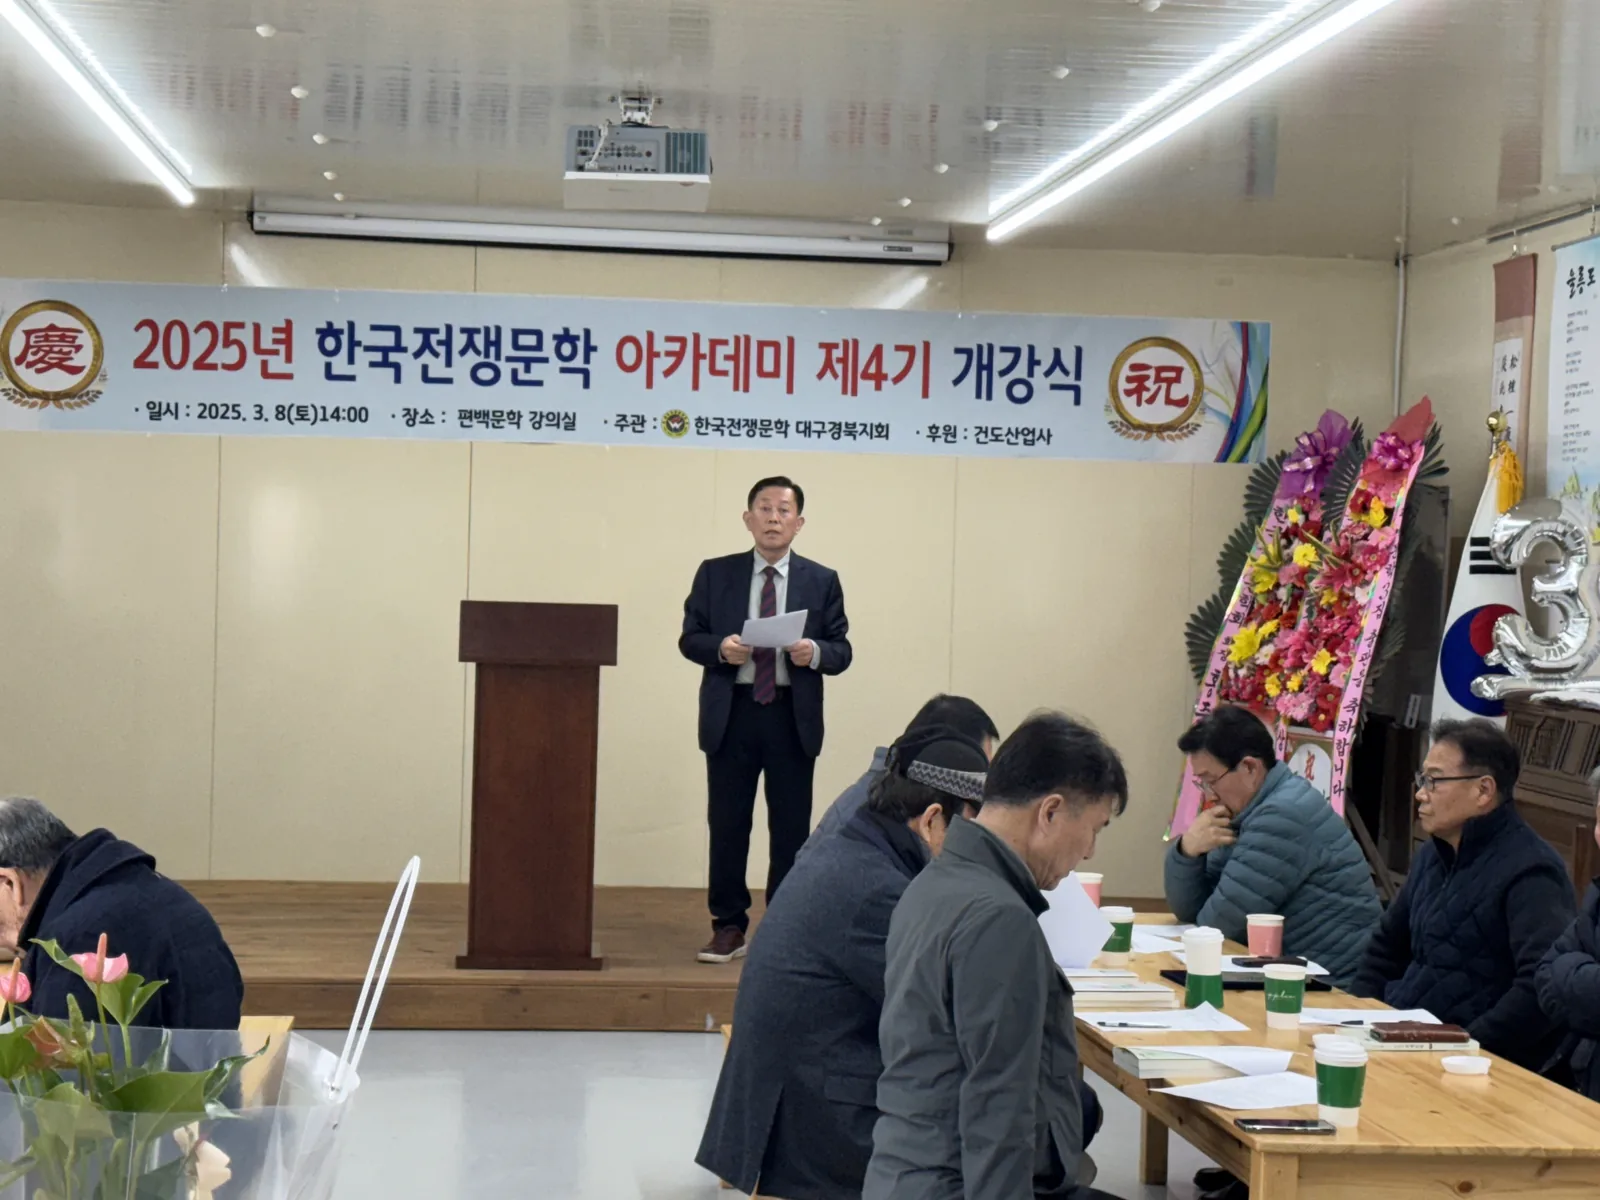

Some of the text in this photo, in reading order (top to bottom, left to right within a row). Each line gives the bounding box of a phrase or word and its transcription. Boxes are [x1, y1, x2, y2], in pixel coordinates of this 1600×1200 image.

[14, 323, 86, 375] 慶
[133, 318, 1083, 406] 2025년 한국전쟁문학 아카데미 제4기 개강식
[1123, 363, 1189, 408] 祝
[457, 409, 523, 430] 편백문학
[528, 410, 577, 431] 강의실
[694, 416, 790, 438] 한국전쟁문학
[795, 420, 890, 441] 대구경북지회
[974, 425, 1053, 446] 건도산업사
[1333, 697, 1359, 797] 축하합니다
